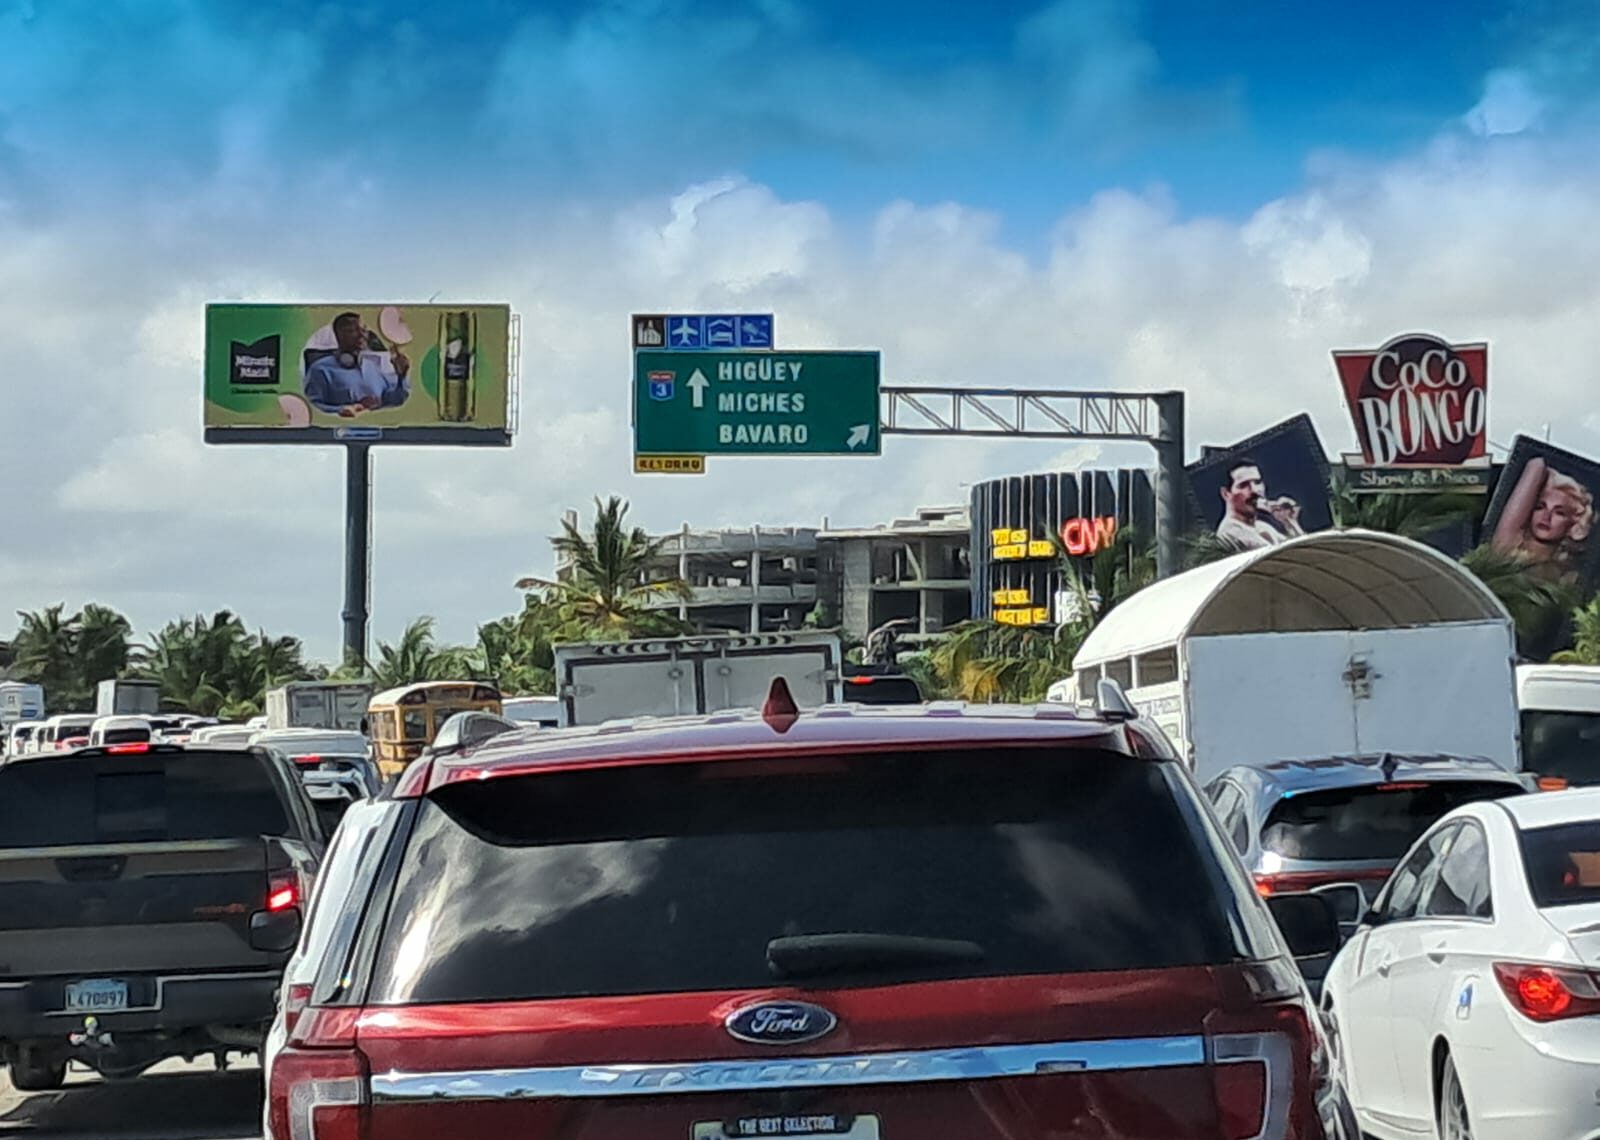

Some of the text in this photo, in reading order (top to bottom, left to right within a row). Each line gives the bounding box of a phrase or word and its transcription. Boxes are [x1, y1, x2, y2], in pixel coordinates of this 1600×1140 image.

[717, 358, 803, 382] HIGÜEY
[1371, 350, 1467, 390] CoCo
[655, 383, 668, 397] 3
[717, 393, 805, 413] MICHES
[719, 424, 808, 444] BAVARO
[1359, 386, 1486, 467] BONGO
[751, 1007, 810, 1033] Ford
[739, 1117, 757, 1134] THE
[784, 1115, 836, 1132] SELECTION
